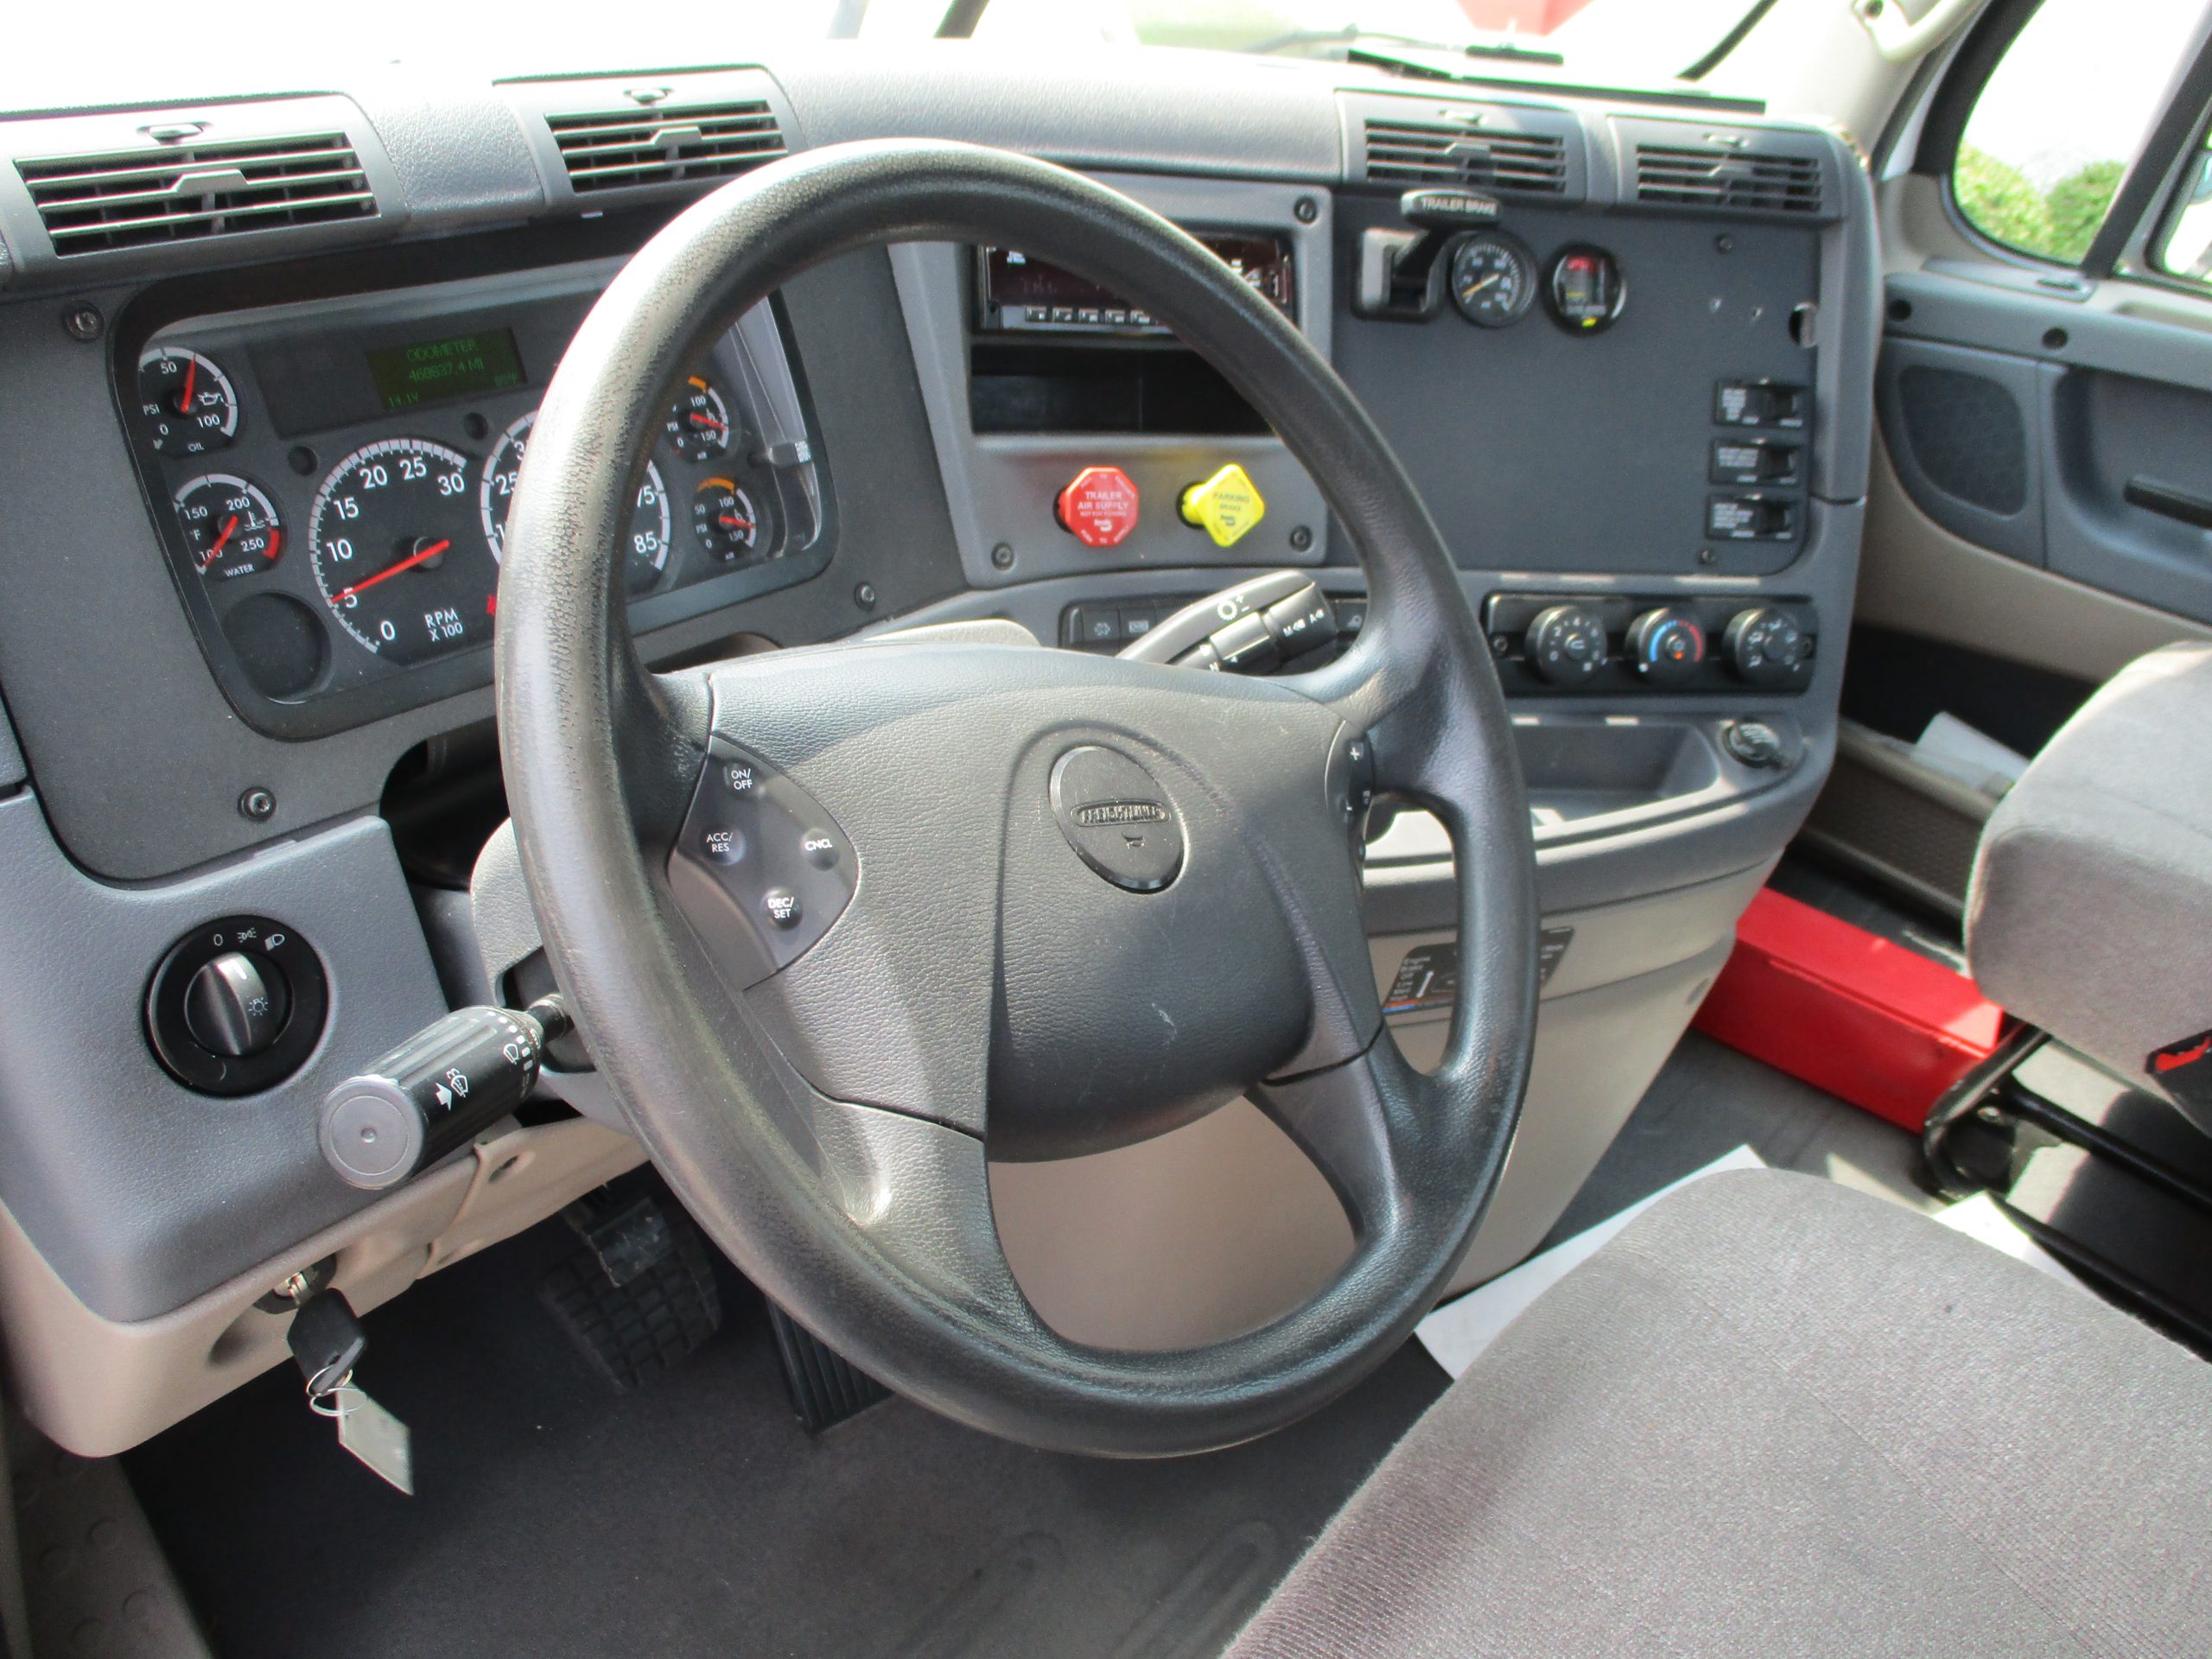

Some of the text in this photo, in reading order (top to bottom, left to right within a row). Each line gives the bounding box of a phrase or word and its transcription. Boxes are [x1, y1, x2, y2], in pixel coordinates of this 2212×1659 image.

[1421, 196, 1497, 215] TRAILER BRAKE
[161, 363, 176, 374] 50
[690, 396, 706, 408] 100
[143, 403, 160, 416] PSI
[195, 415, 220, 428] 100
[666, 422, 679, 433] PSI
[159, 423, 168, 435] 0
[701, 430, 716, 442] 150
[188, 442, 205, 452] OIL
[677, 437, 684, 448] 0
[514, 441, 525, 461] 3
[399, 456, 427, 480] 25
[359, 465, 388, 490] 20
[437, 473, 465, 496] 30
[1085, 491, 1122, 500] TRAILER
[1213, 492, 1249, 505] PARKING
[226, 496, 250, 512] 200
[718, 496, 734, 508] 100
[1077, 501, 1129, 511] AIR SUPPLY
[184, 505, 208, 520] 150
[334, 497, 359, 520] 15
[694, 504, 706, 514] 50
[696, 524, 708, 534] PSI
[633, 531, 658, 554] 85
[728, 531, 744, 542] 150
[241, 537, 264, 552] 250
[705, 538, 713, 549] 0
[326, 538, 353, 562] 10
[224, 563, 255, 577] WATER
[343, 588, 358, 608] 5
[423, 607, 458, 628] RPM
[380, 620, 396, 640] 0
[429, 622, 463, 642] X 100
[731, 768, 751, 779] ON/
[734, 779, 753, 790] OFF
[706, 832, 733, 843] ACC/
[711, 843, 729, 853] RES
[804, 839, 832, 851] CNCL
[767, 897, 794, 909] DEC/
[773, 908, 791, 918] SET
